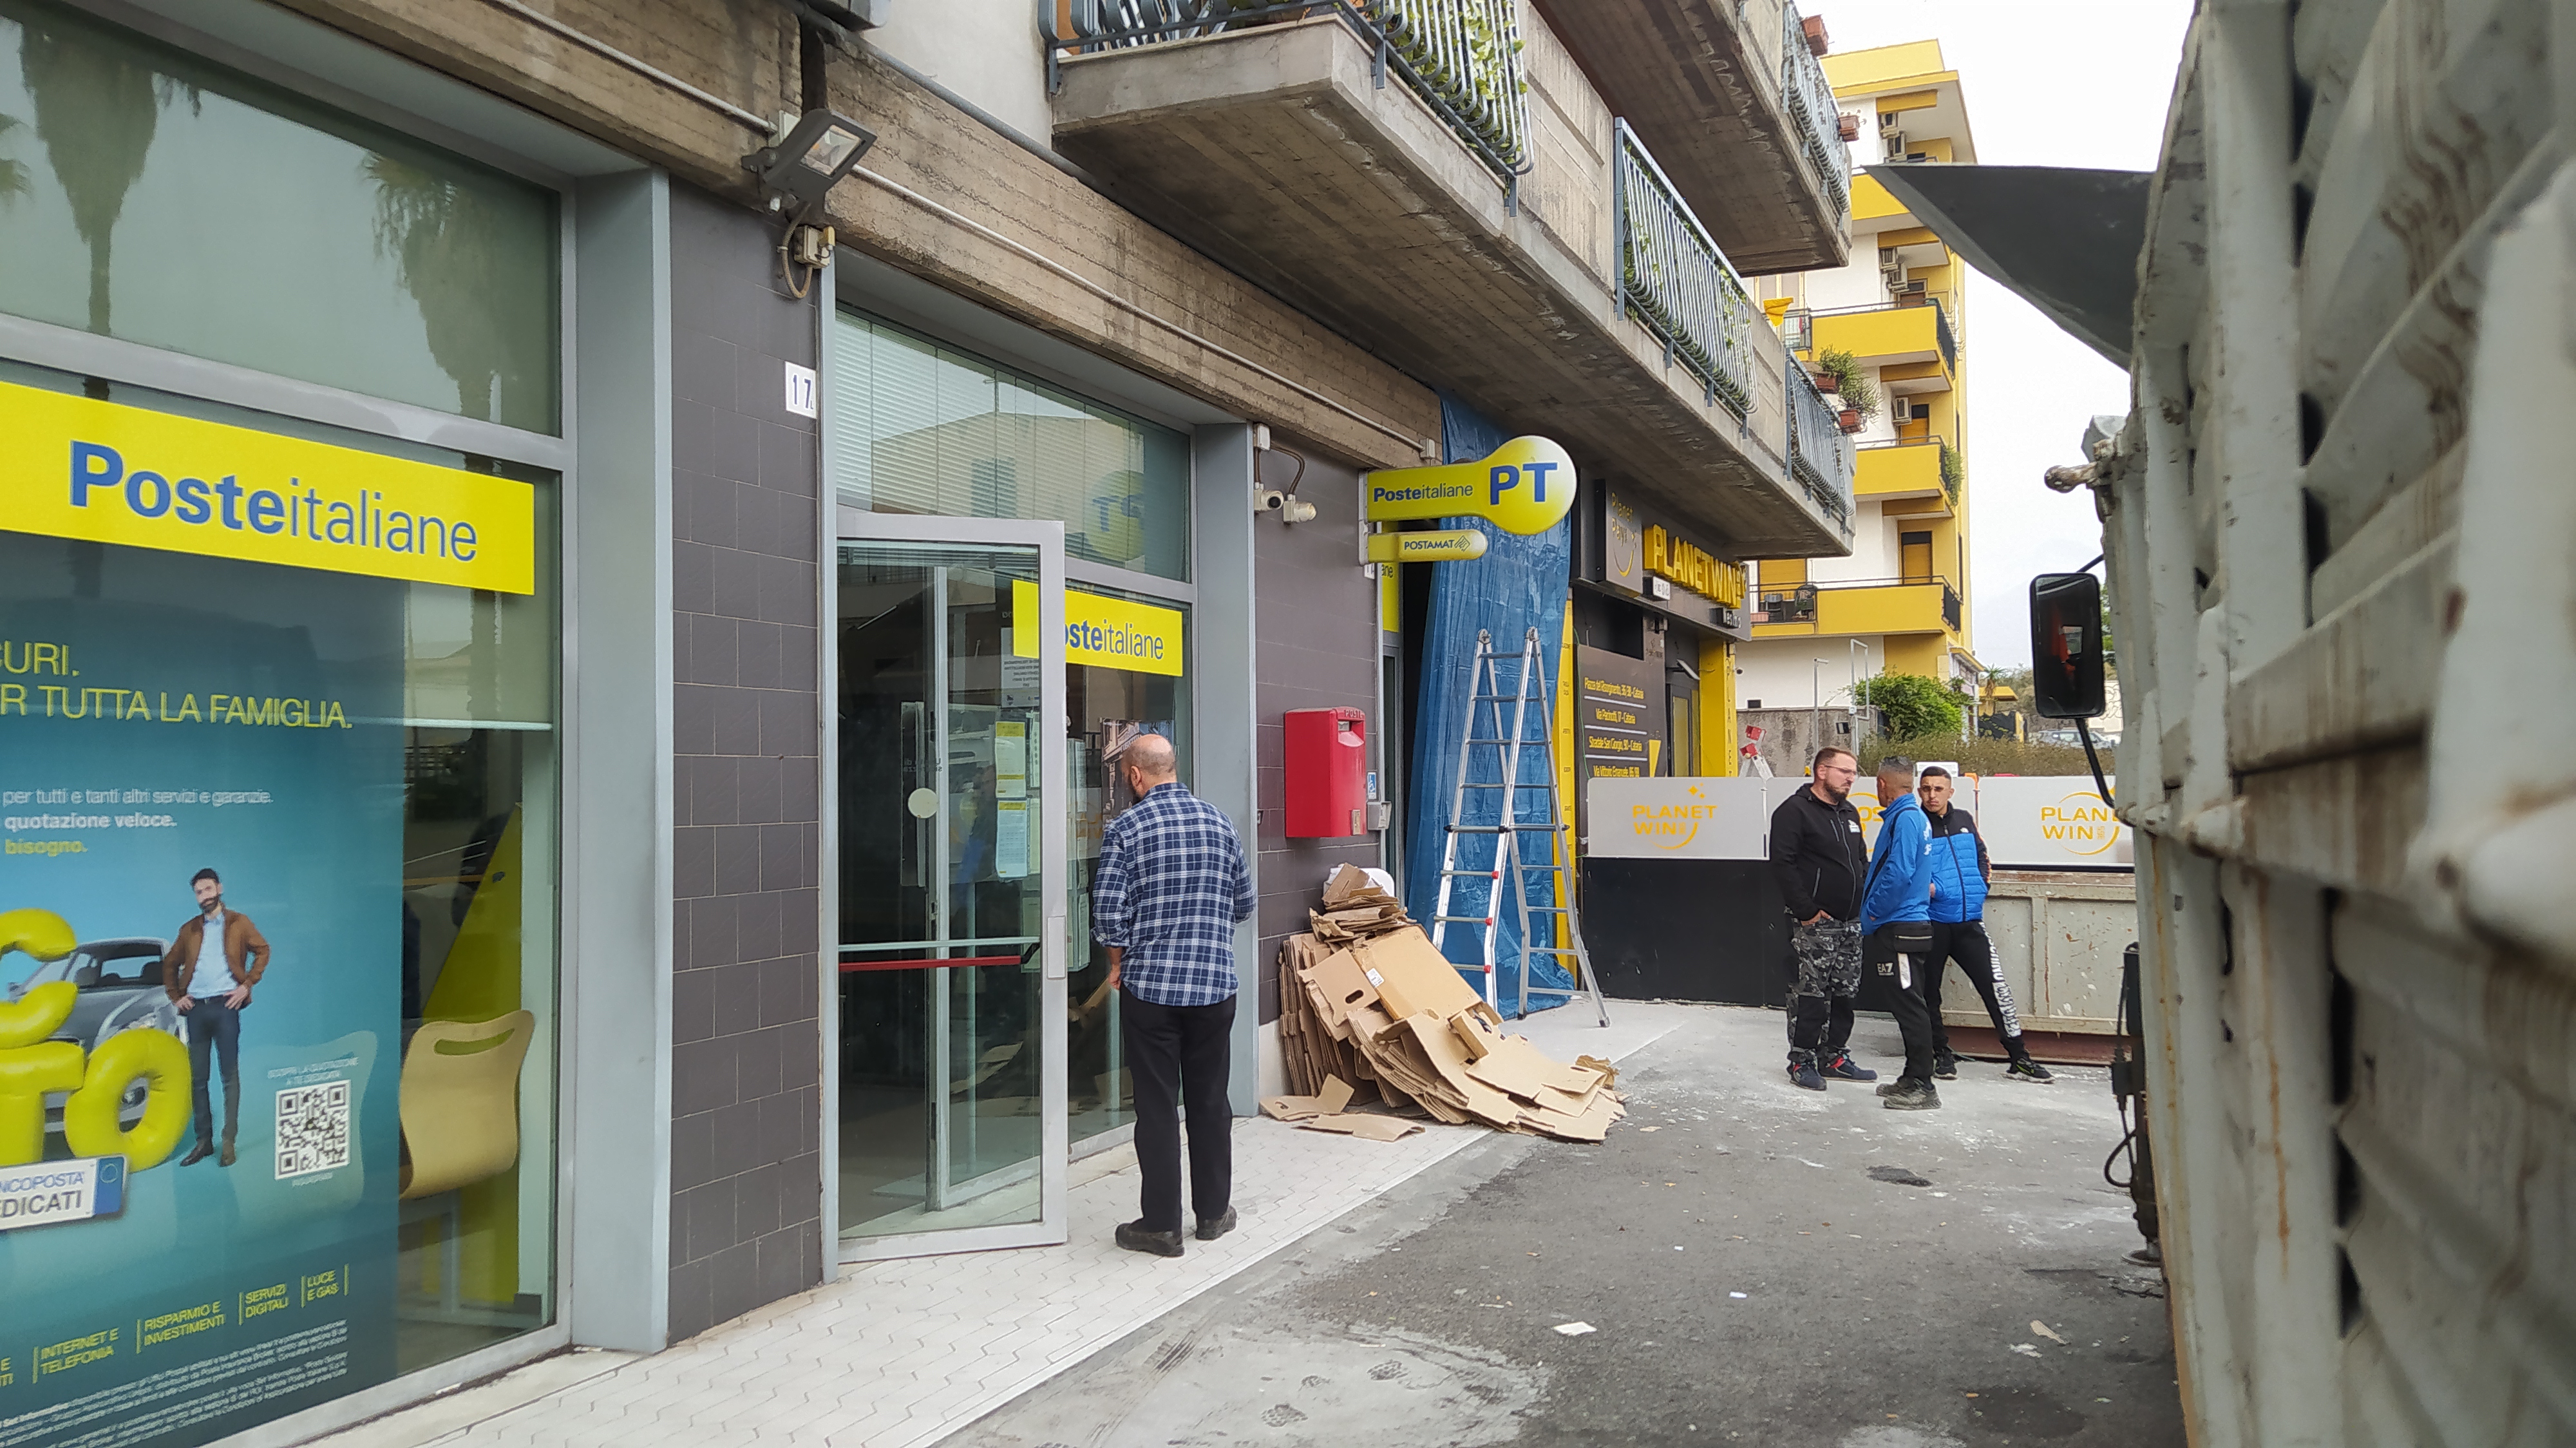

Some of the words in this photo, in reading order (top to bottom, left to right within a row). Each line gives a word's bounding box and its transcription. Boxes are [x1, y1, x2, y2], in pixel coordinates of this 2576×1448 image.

[1374, 483, 1473, 502] Posteitaliane
[1490, 462, 1558, 505] PT
[69, 439, 478, 563] Posteitaliane
[1404, 538, 1455, 551] POSTAMAT
[0, 640, 80, 676] URI.
[37, 685, 152, 721] TUTTA
[160, 691, 201, 723] LA
[211, 694, 353, 729] FAMIGLIA.
[3, 791, 35, 808] per
[36, 788, 67, 805] tutti
[71, 790, 83, 805] e
[86, 788, 120, 805] tanti
[122, 788, 150, 805] altri
[153, 788, 198, 805] servizi
[199, 791, 211, 805] e
[5, 813, 111, 832] quotazione
[115, 812, 178, 828] veloce.
[1632, 805, 1718, 819] PLANET
[5, 839, 88, 857] bisogno.
[1877, 962, 1893, 973] EA7
[307, 1270, 336, 1288] LUCE
[245, 1282, 287, 1304] SERVIZI
[307, 1290, 315, 1302] E
[316, 1282, 340, 1299] GAS
[144, 1304, 211, 1331] RISPARMIO
[212, 1300, 222, 1314] E
[245, 1297, 289, 1319] DIGITALI
[144, 1314, 225, 1346] INVESTIMENTI
[41, 1330, 108, 1360] INTERNET
[109, 1327, 120, 1342] E
[40, 1345, 114, 1375] TELEFONIA
